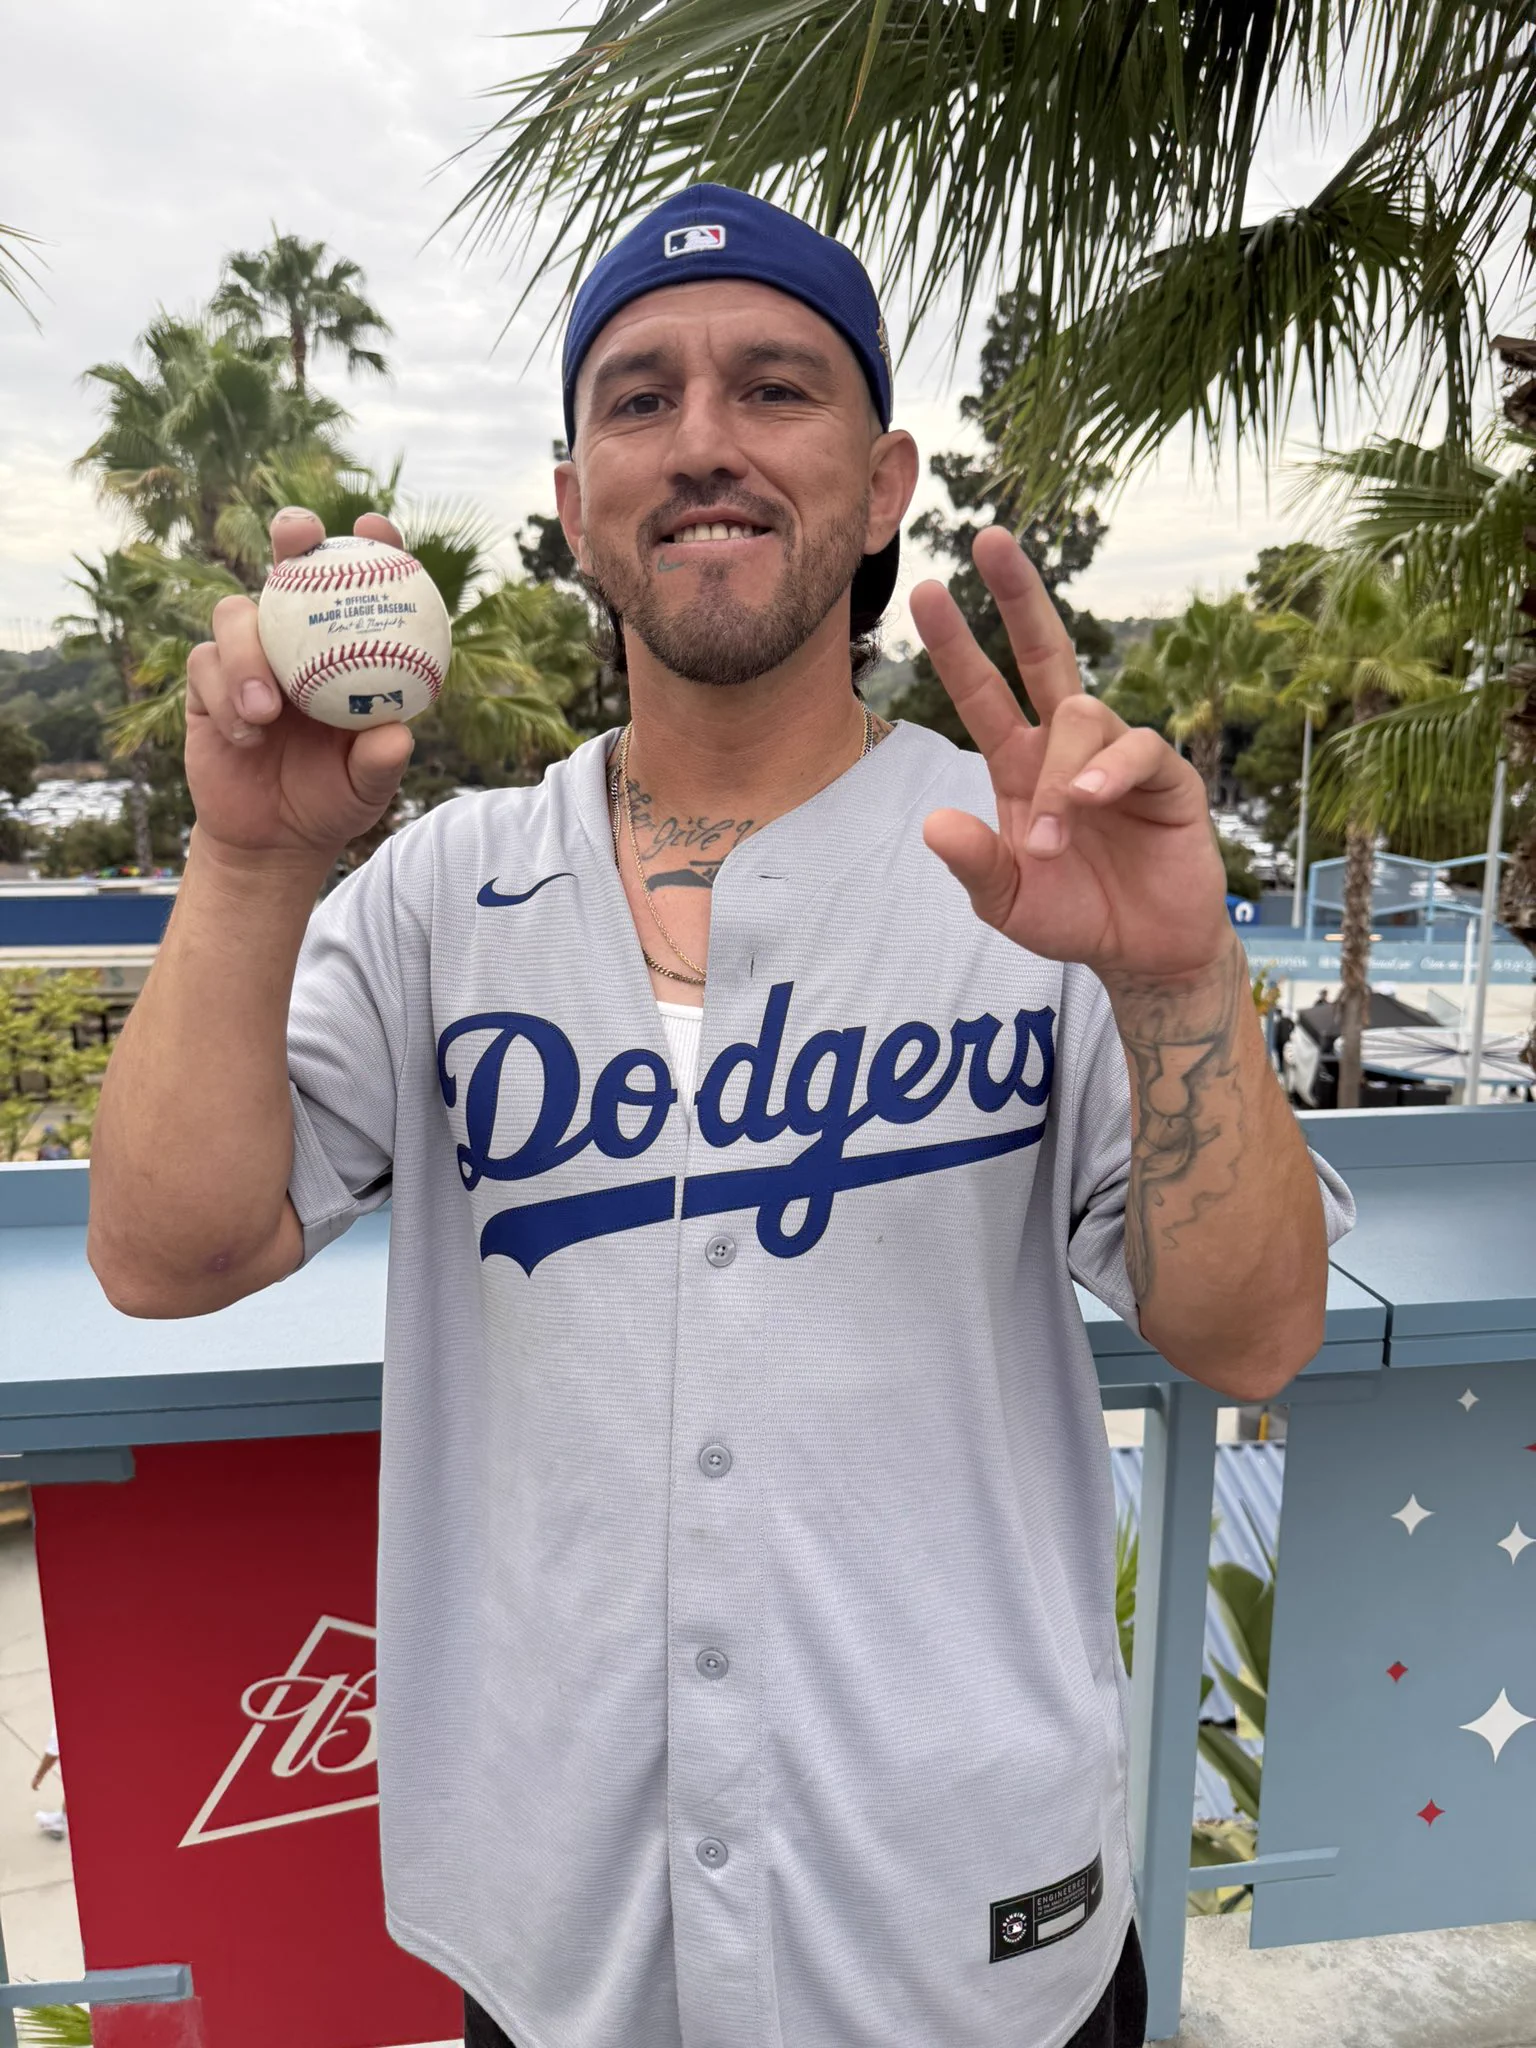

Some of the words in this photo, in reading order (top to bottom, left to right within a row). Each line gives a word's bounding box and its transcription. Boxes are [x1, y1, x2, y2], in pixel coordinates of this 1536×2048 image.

[345, 594, 380, 605] OFFICIAL
[309, 608, 341, 626] MAJOR
[344, 604, 375, 618] LEAGUE
[378, 603, 417, 613] BASEBALL
[437, 981, 1056, 1259] Dodgers
[1037, 1877, 1086, 1905] ENGINEERED
